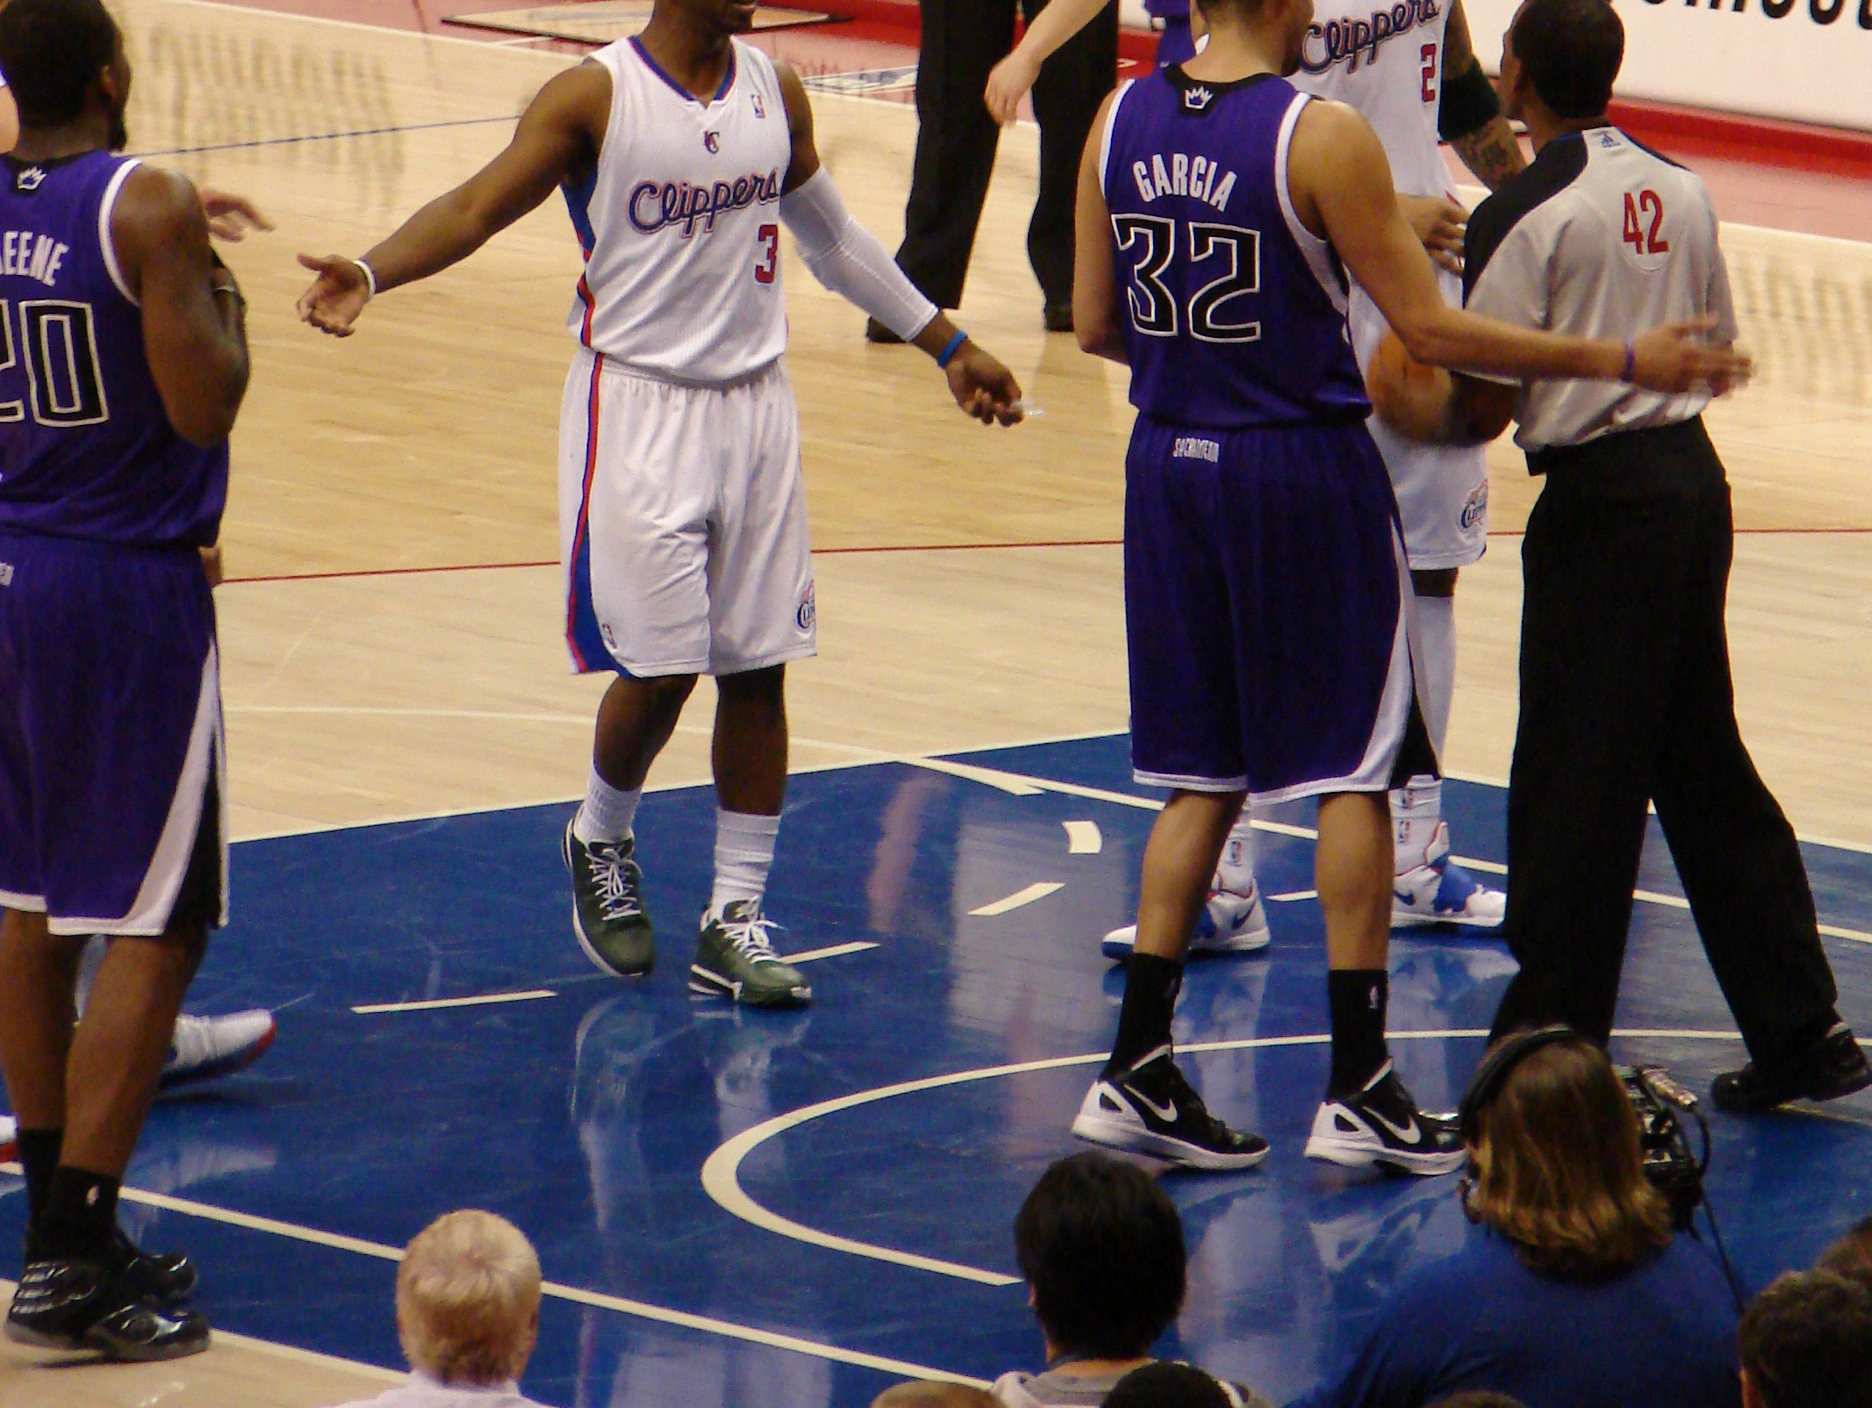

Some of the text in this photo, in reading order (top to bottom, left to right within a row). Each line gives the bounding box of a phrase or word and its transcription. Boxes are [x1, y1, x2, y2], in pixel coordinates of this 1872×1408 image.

[1420, 42, 1437, 103] 2
[626, 167, 781, 239] Clippers
[1132, 153, 1238, 213] GARCIA
[1623, 189, 1669, 255] 42
[0, 230, 70, 287] EENE
[755, 224, 779, 284] 3
[1111, 212, 1262, 343] 32
